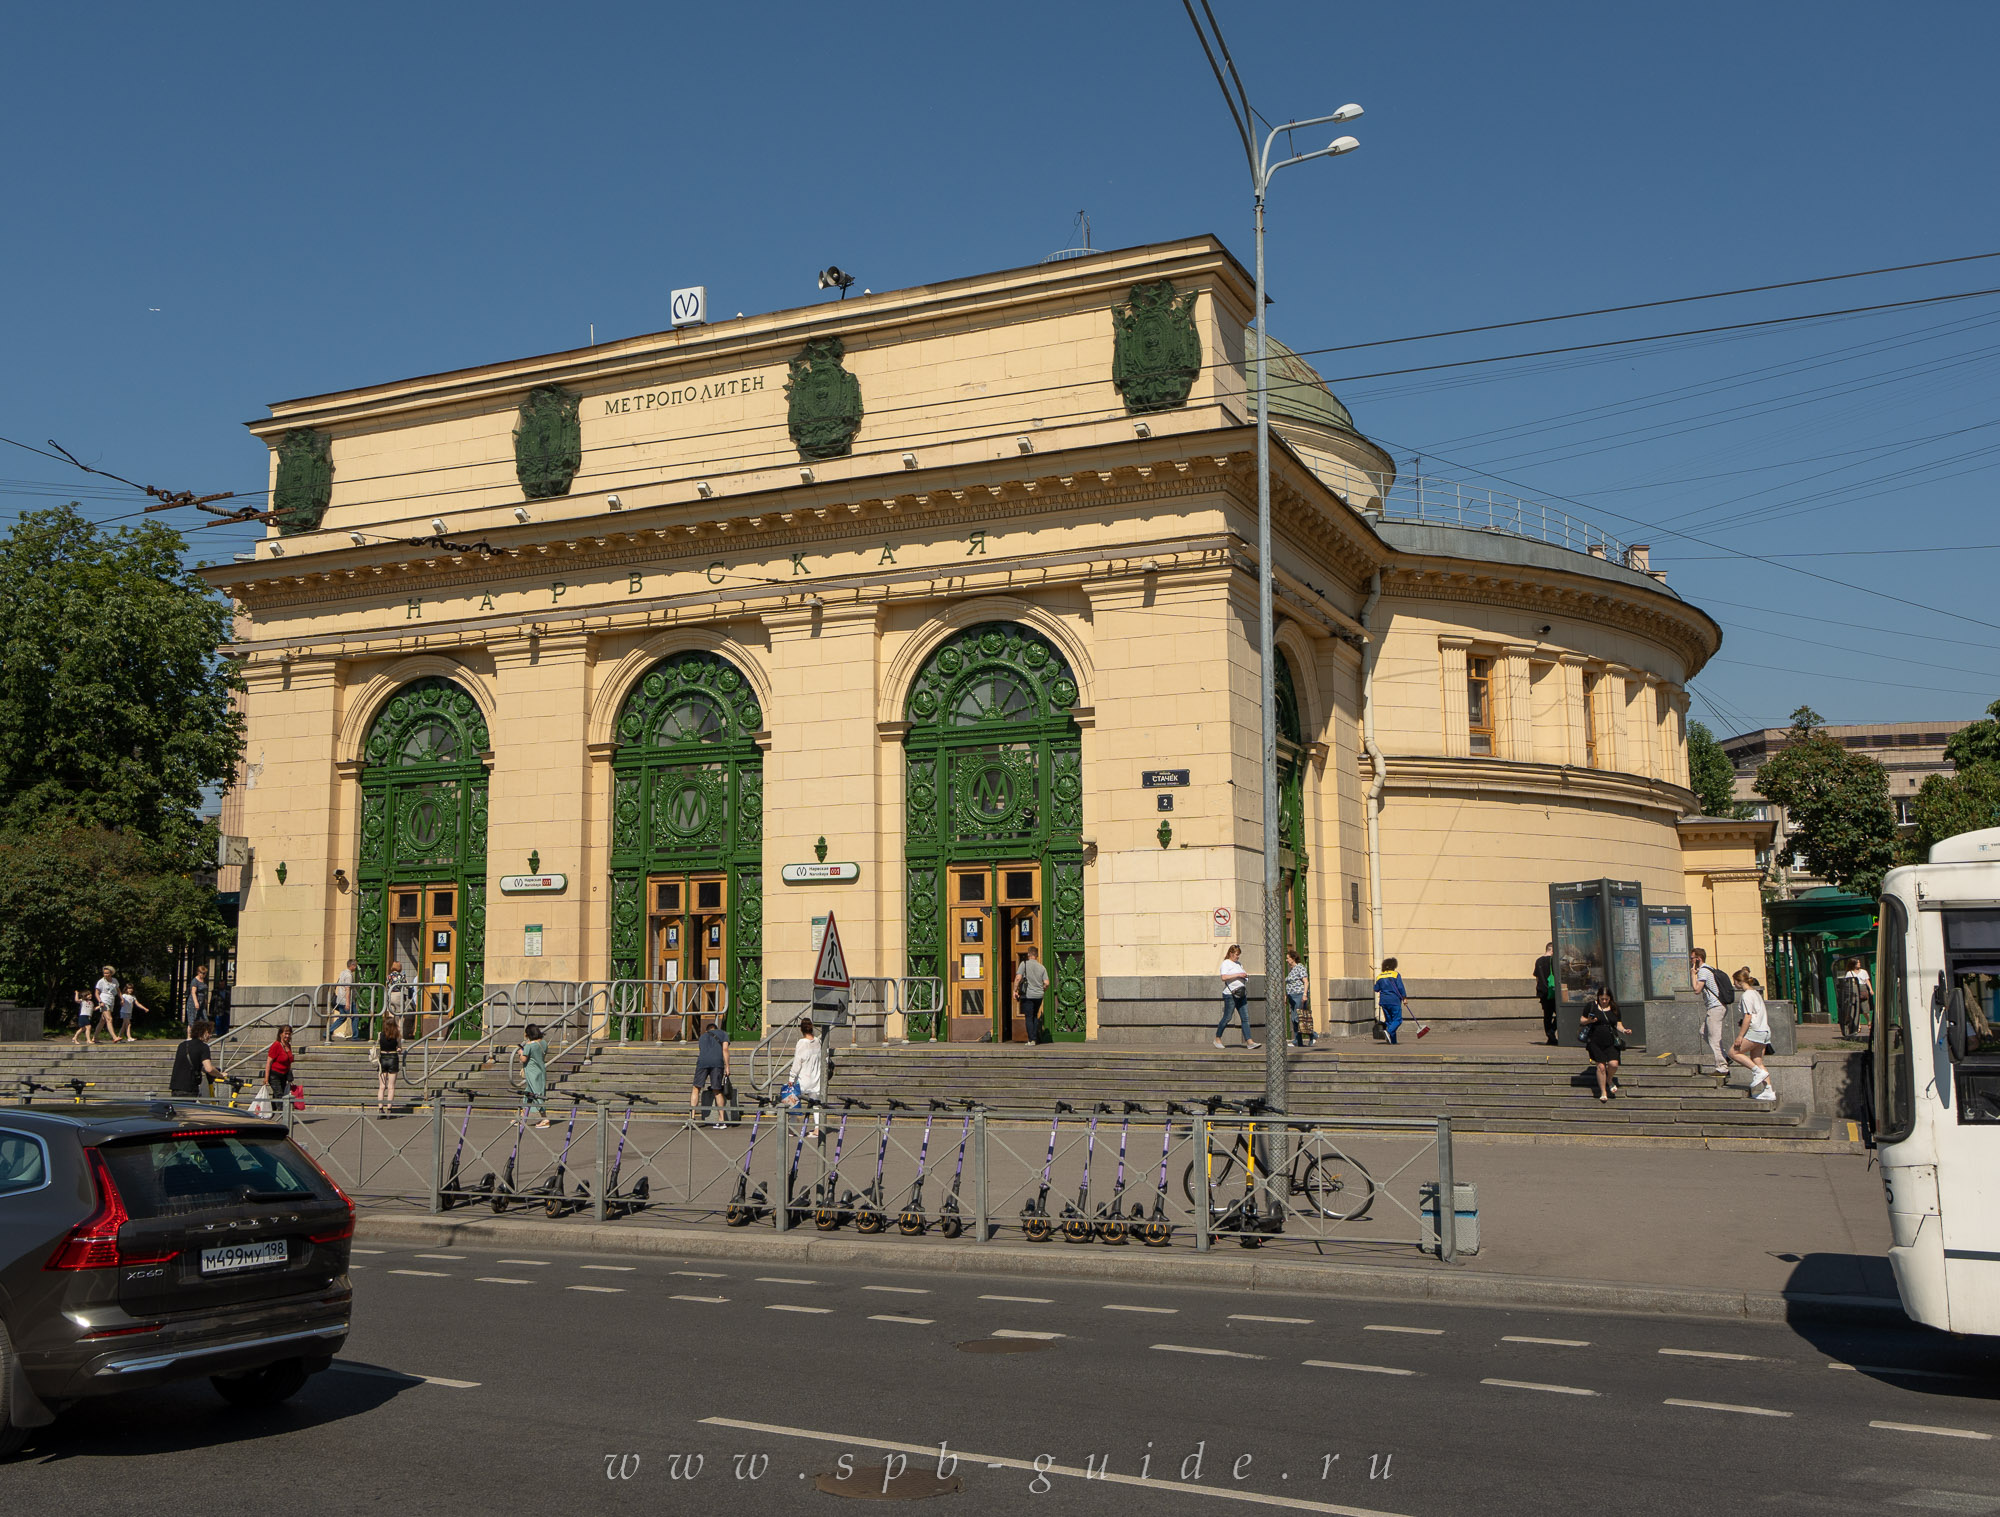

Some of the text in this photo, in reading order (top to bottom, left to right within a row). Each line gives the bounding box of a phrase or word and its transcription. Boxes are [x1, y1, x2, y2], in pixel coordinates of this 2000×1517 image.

[605, 376, 765, 415] МЕТРОПОЛИТЕН
[406, 530, 987, 619] НАРВСКАЯ
[1152, 774, 1179, 782] СТАЧЕК
[204, 1215, 298, 1230] VOLVO
[264, 1241, 284, 1256] 198
[126, 1268, 164, 1280] XC60
